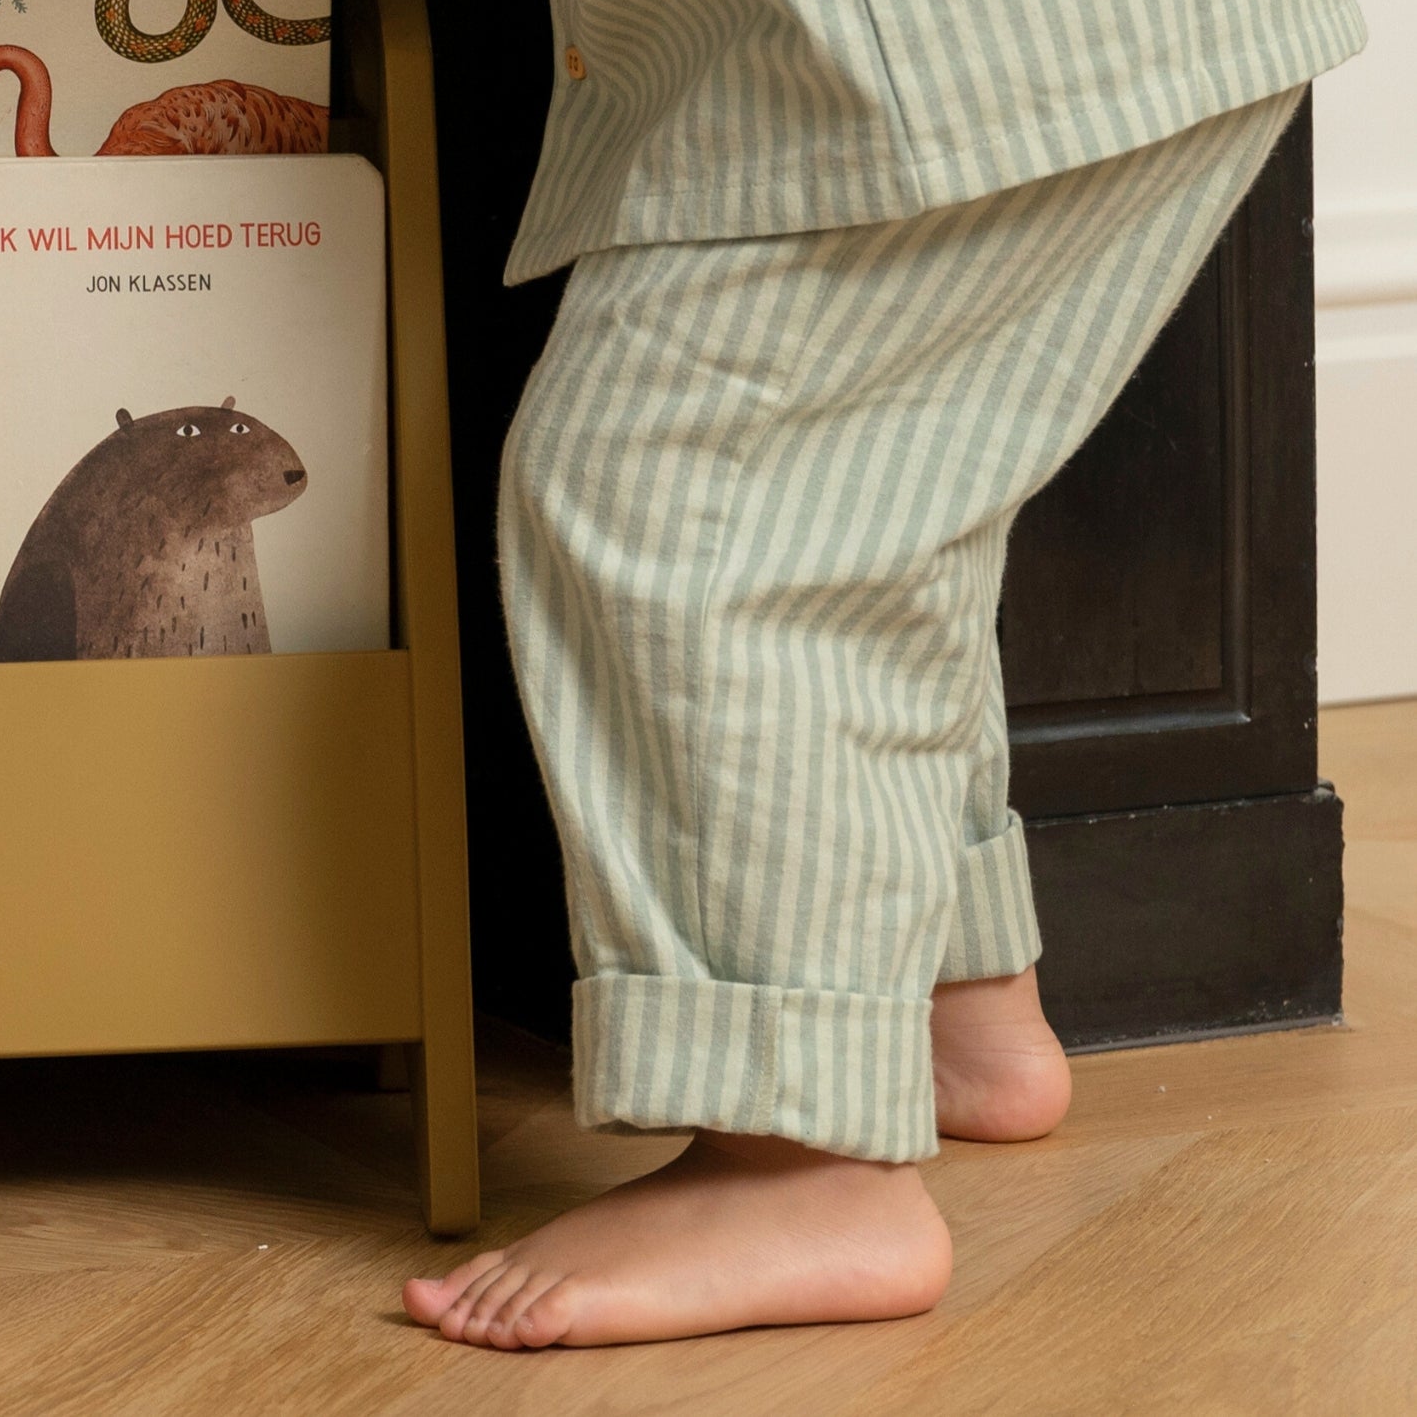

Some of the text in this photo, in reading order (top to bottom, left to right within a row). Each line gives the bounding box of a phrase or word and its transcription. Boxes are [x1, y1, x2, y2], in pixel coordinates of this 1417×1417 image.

[27, 226, 78, 252] WIL
[87, 225, 154, 251] MIJN
[165, 223, 233, 249] HOED
[240, 221, 322, 248] TERUG
[86, 273, 212, 293] JON KLASSEN
